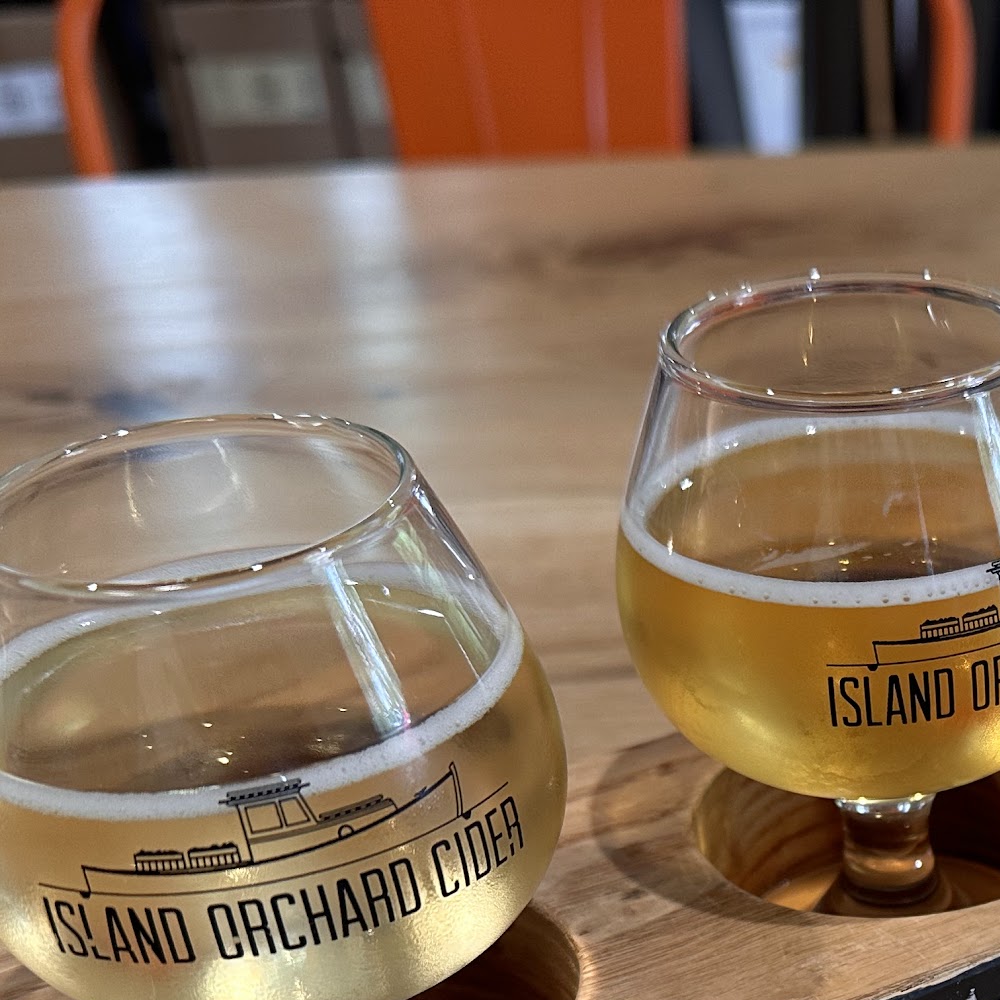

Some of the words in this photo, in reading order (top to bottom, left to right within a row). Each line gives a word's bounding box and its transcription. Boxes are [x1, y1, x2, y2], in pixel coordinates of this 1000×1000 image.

[827, 668, 955, 727] ISLAND
[43, 897, 196, 964] ISLAND
[208, 858, 422, 959] ORCHARD
[431, 796, 523, 898] CIDER
